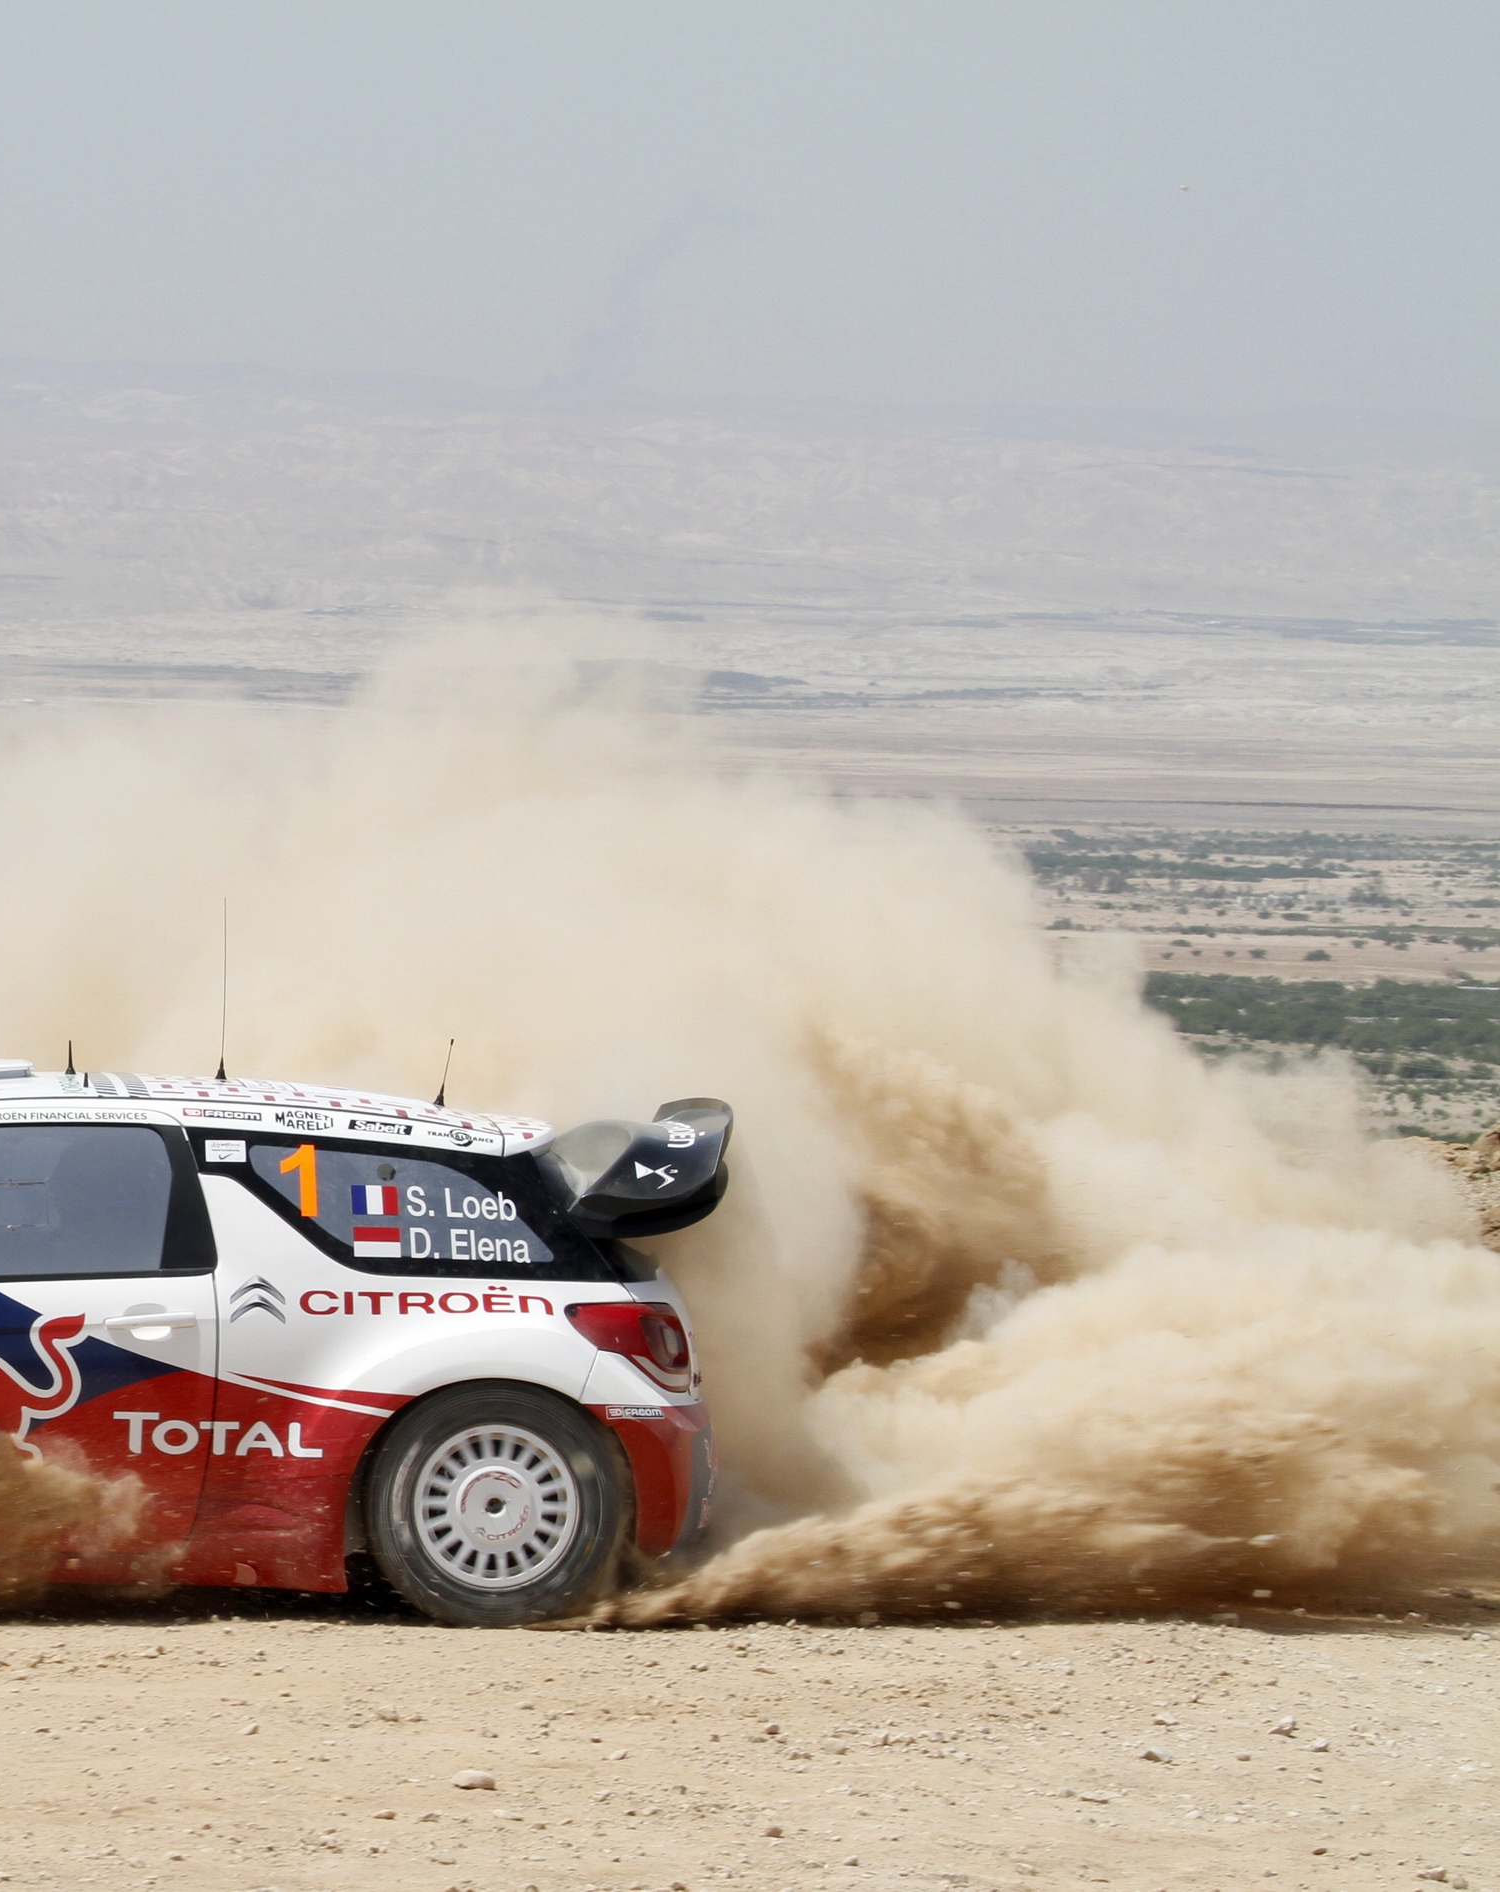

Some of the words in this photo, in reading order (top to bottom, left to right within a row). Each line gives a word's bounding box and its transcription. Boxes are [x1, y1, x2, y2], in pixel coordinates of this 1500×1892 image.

[30, 1112, 92, 1121] FINANCIAL
[95, 1112, 148, 1121] SERVICES
[204, 1109, 262, 1121] FACOM
[275, 1110, 333, 1124] MAGNETI
[353, 1120, 407, 1135] Sabelt
[279, 1144, 319, 1218] 1
[405, 1185, 435, 1218] S.
[444, 1187, 517, 1221] Loeb
[409, 1227, 440, 1260] D.
[450, 1228, 532, 1264] Elena
[624, 1407, 663, 1418] FACOM
[113, 1411, 323, 1458] TOTAL
